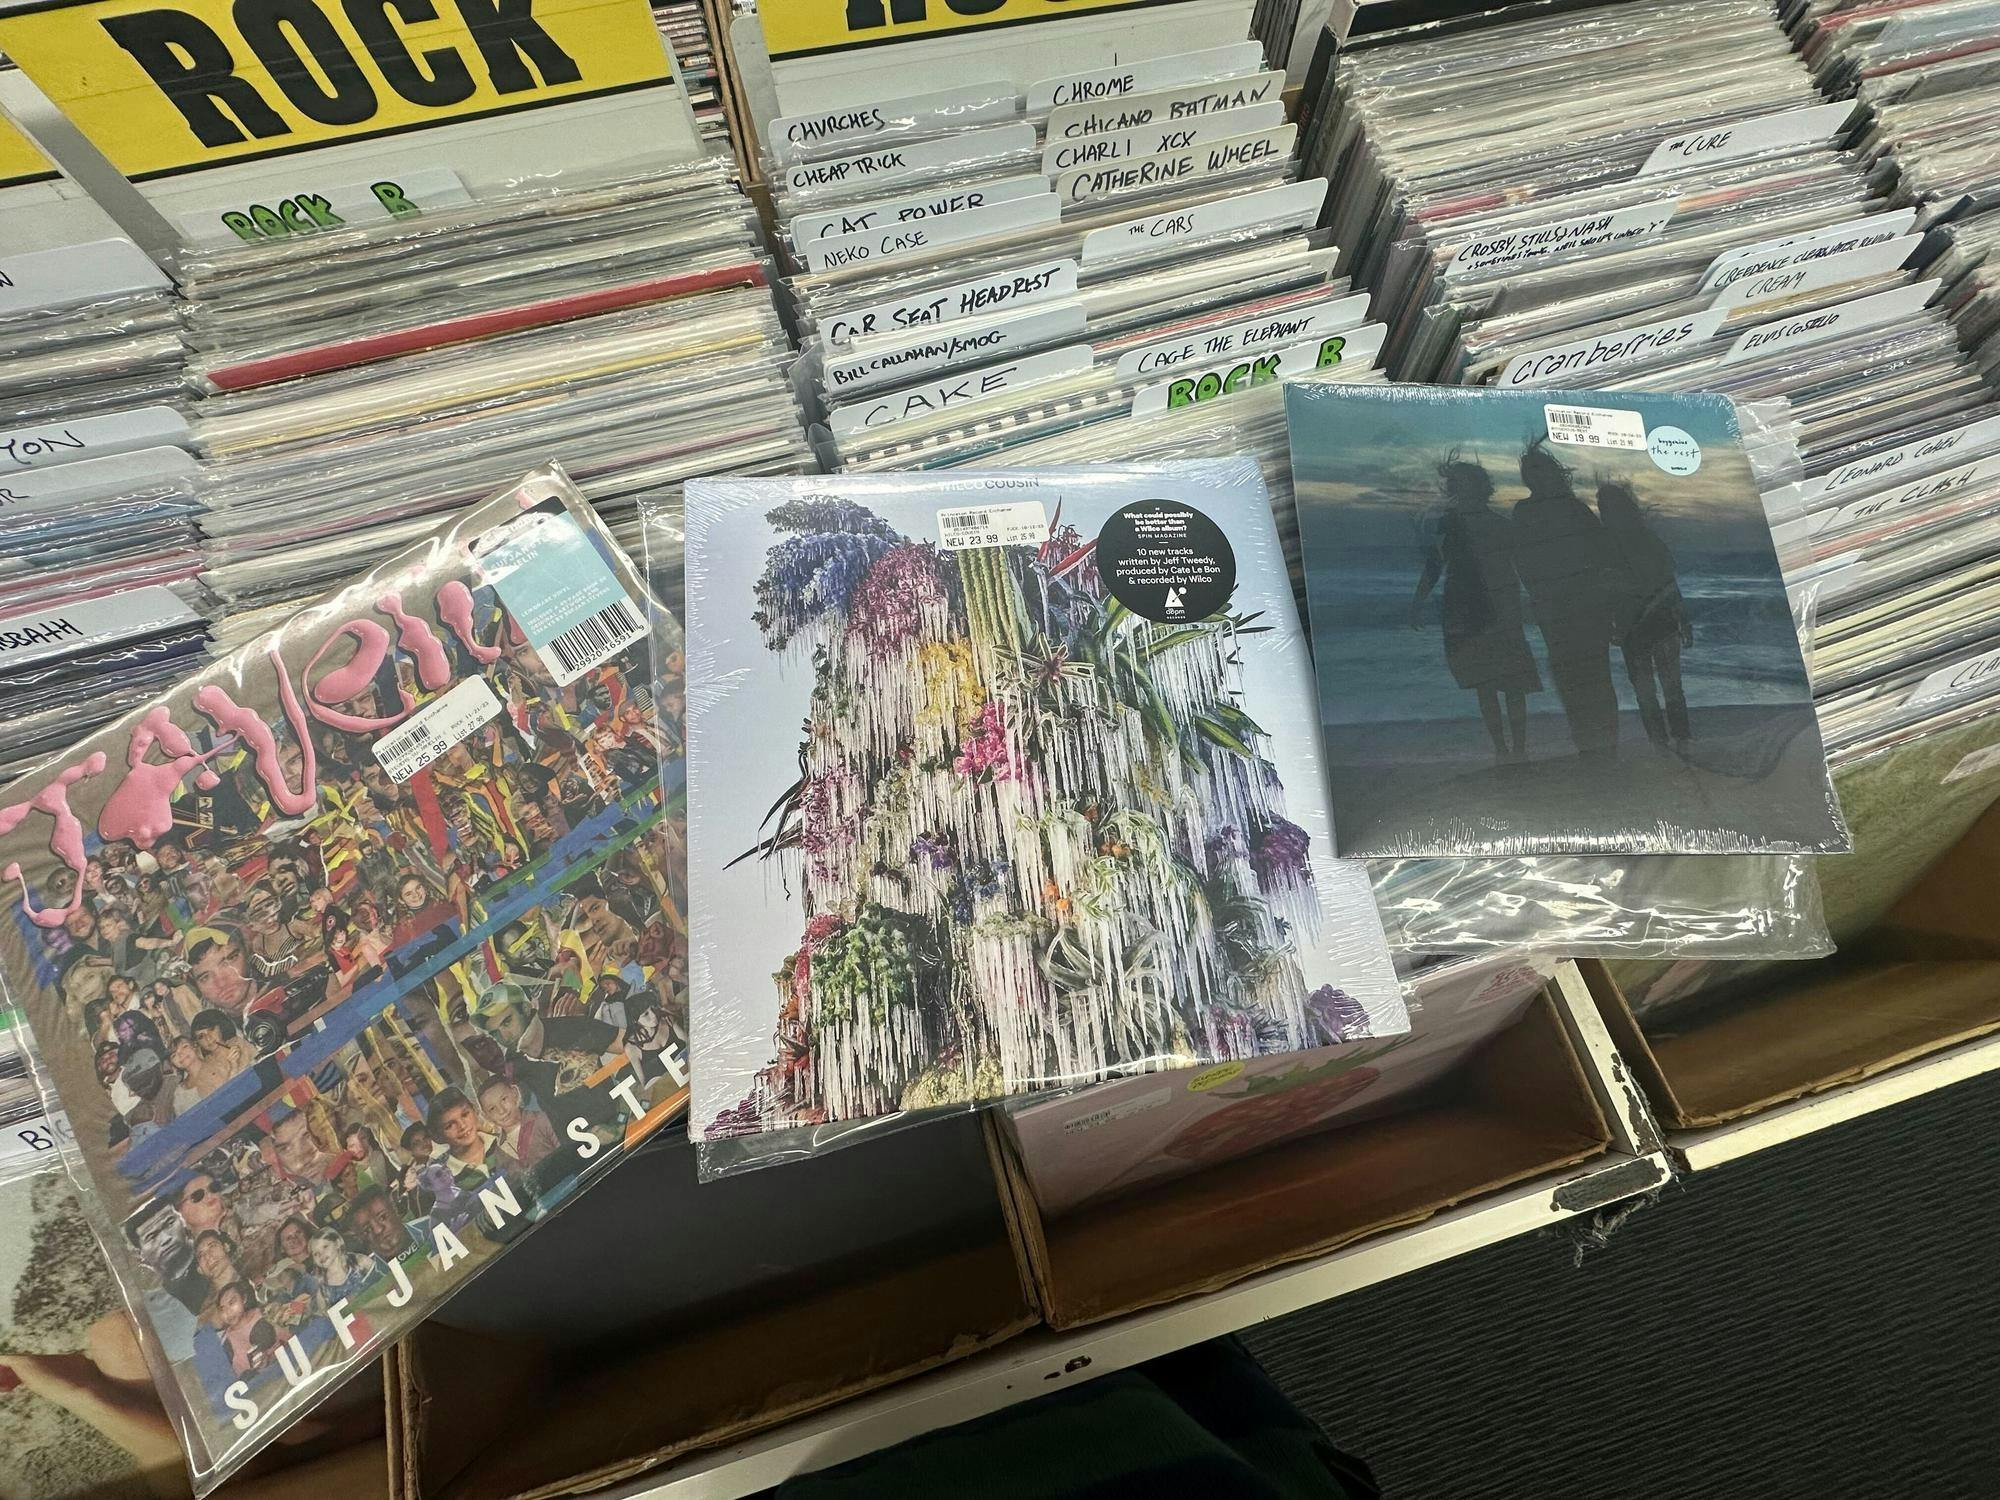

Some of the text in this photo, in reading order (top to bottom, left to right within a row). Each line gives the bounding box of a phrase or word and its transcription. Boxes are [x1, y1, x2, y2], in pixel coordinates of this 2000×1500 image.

[98, 0, 582, 149] ROCK
[1053, 75, 1134, 106] CHROME
[1064, 109, 1153, 139] CHICANO
[1169, 80, 1271, 120] BATMAN
[1056, 130, 1197, 169] CHARLI XCX
[1684, 131, 1732, 155] CURE
[793, 152, 906, 188] CHEAP TRICK
[1071, 139, 1279, 202] CATHERINE WHEEL
[221, 193, 346, 245] ROCK
[820, 193, 985, 239] CAT POWER
[1128, 214, 1195, 237] THE CARS
[824, 231, 929, 269] NEKO CASE
[1714, 256, 1788, 288] CREEDENCE
[1746, 271, 1807, 298] CREAM
[831, 267, 1061, 346] CAR SEAT HEADREST
[1138, 316, 1316, 374] CAGE THE ELEPHANT
[1743, 313, 1840, 352] ELVIS COSTELLO
[1512, 322, 1694, 385] cranberries
[833, 366, 870, 386] BILL
[1167, 336, 1346, 409] ROCK B
[864, 367, 1018, 427] CAKE
[1553, 432, 1569, 441] NEW
[1651, 447, 1700, 459] the rest
[1825, 431, 1966, 491] LEONARD COHEN
[985, 477, 1040, 490] COUSIN
[1854, 467, 1978, 519] THE CLASH
[1164, 511, 1193, 519] possibly
[946, 537, 965, 547] NEW
[1136, 548, 1146, 556] 10
[1116, 567, 1156, 577] produced
[1158, 567, 1168, 576] by
[1204, 565, 1221, 573] Bon
[1118, 556, 1216, 567] written by Jeff Tweedy,
[1137, 577, 1175, 585] recorded
[1176, 576, 1187, 585] by
[1188, 575, 1212, 583] Wilco
[561, 624, 645, 681] 7 29920 16591 9
[392, 764, 413, 783] NEW
[224, 1175, 524, 1430] SUFJAN
